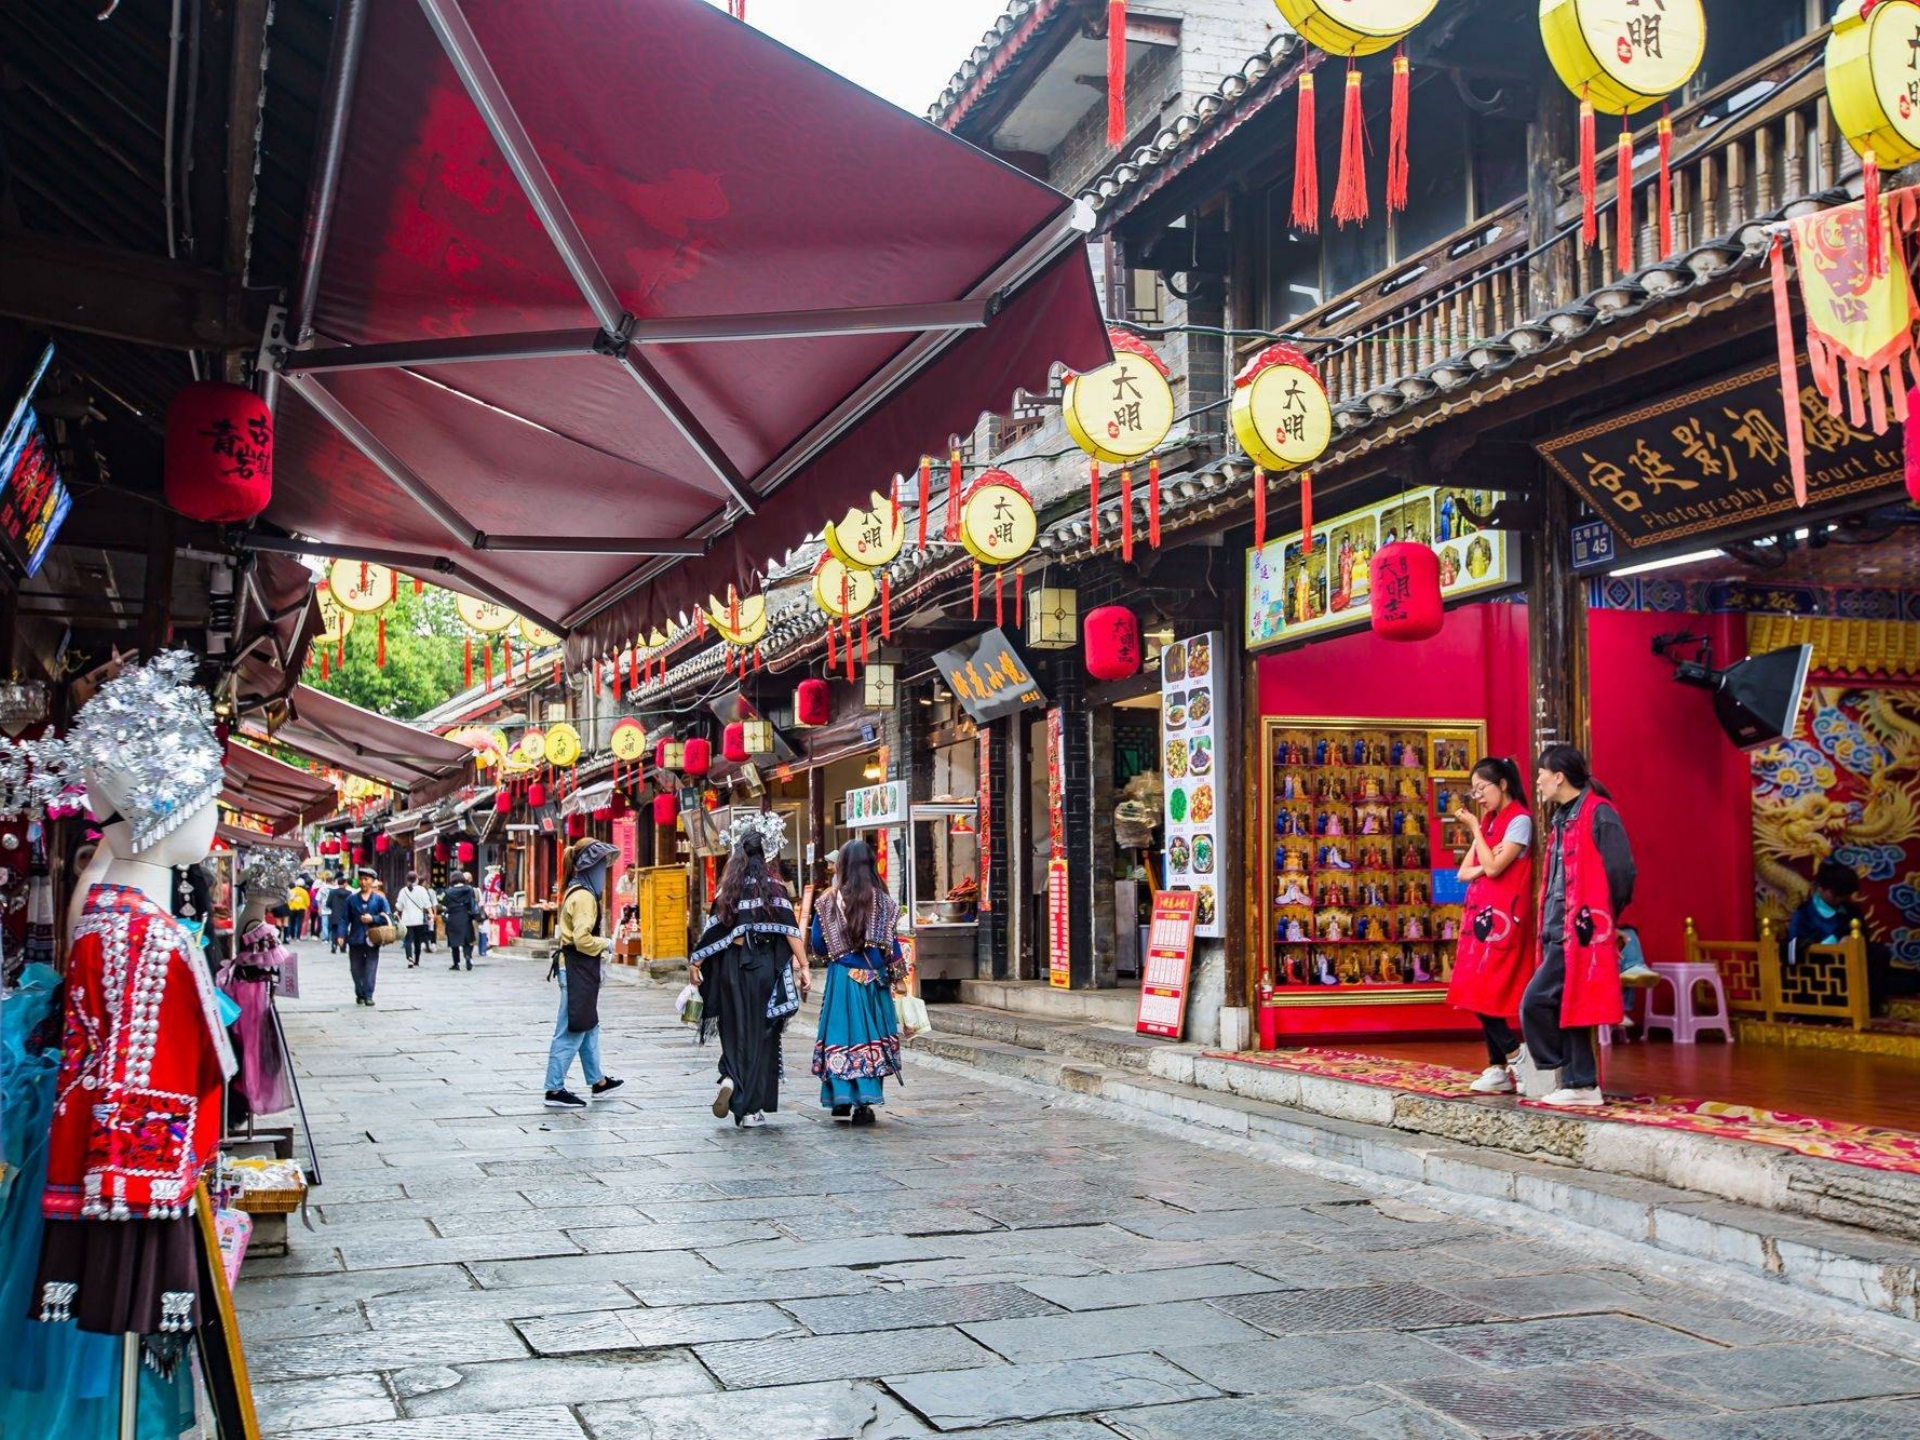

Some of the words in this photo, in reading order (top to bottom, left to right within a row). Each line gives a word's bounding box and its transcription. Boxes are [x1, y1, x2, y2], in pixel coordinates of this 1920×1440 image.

[1626, 0, 1665, 58] 明
[1112, 366, 1143, 431] 大明
[1282, 379, 1307, 442] 大明
[1581, 366, 1900, 512] 宫廷影视摄
[993, 496, 1015, 543] 大明
[1641, 487, 1767, 528] Photography
[1592, 537, 1607, 553] 45
[323, 598, 337, 630] 大明
